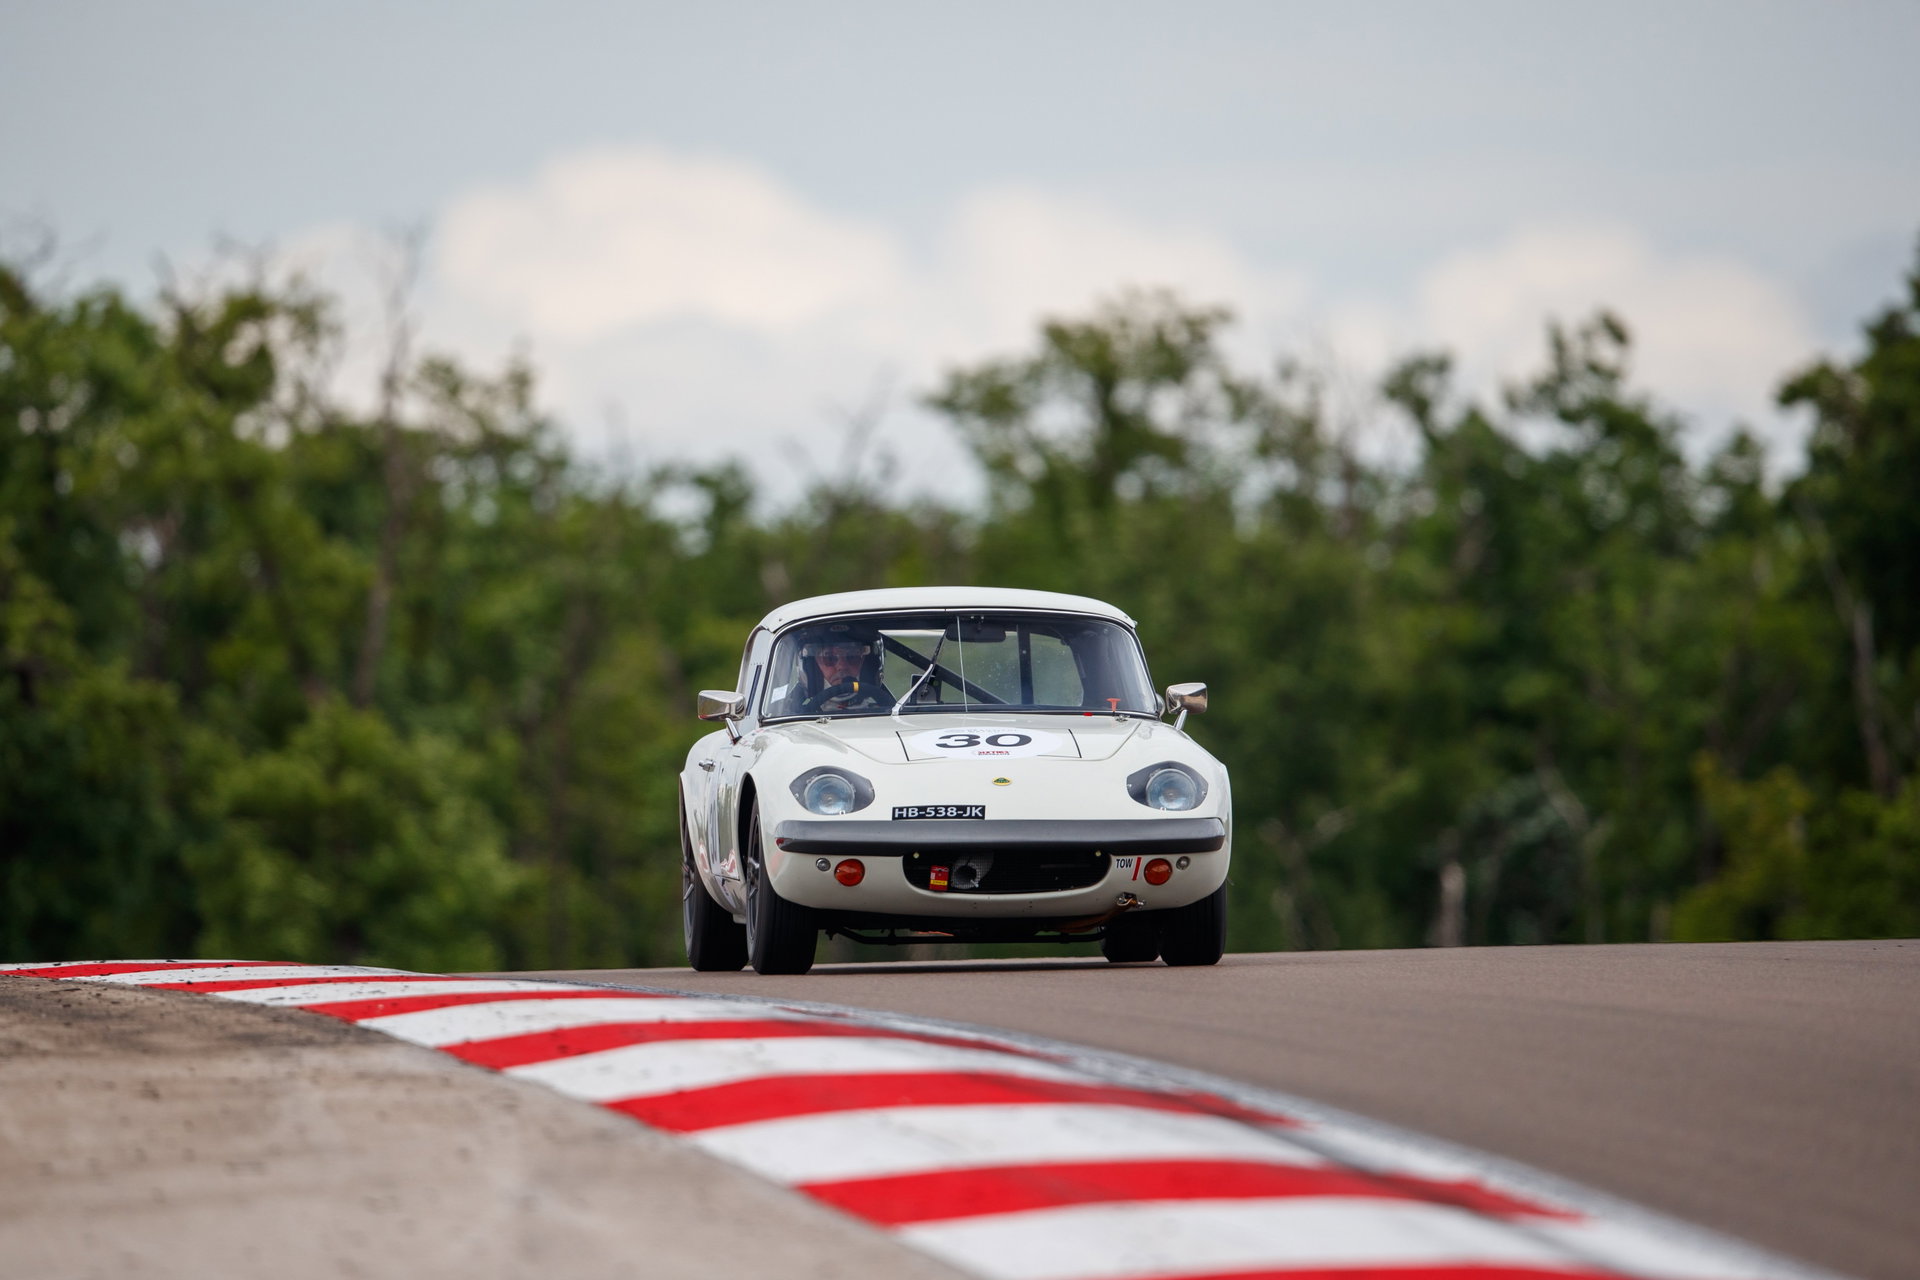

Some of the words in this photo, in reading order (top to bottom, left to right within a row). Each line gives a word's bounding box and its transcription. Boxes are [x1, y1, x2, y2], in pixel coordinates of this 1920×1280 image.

[935, 733, 1033, 749] 30
[894, 806, 983, 818] HB-538-JK
[1115, 858, 1133, 869] TOW
